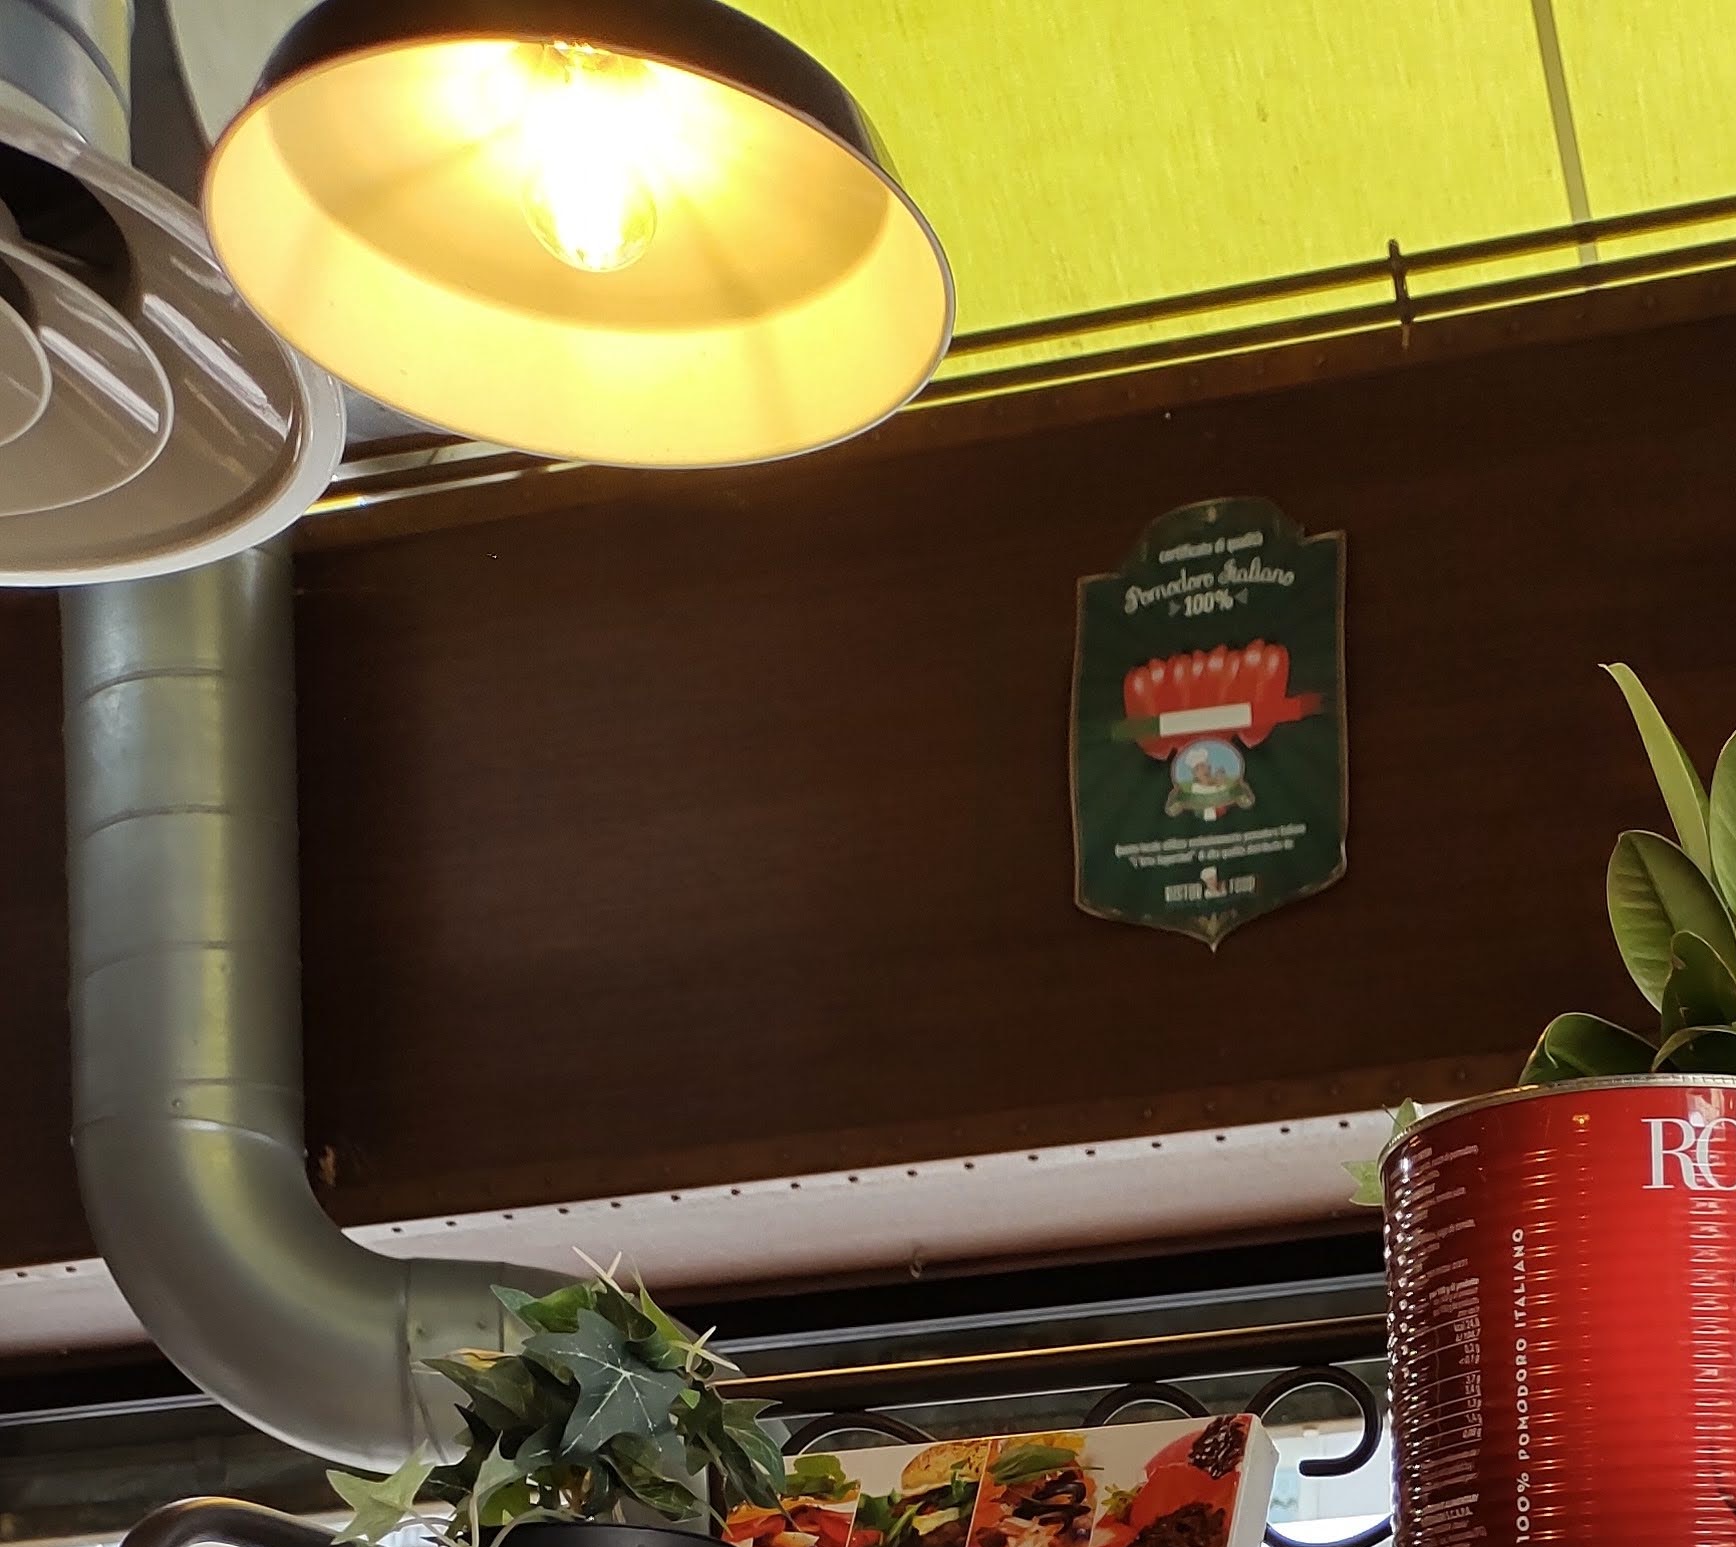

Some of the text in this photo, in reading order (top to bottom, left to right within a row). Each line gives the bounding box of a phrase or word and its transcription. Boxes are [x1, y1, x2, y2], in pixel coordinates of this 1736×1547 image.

[1184, 588, 1235, 617] 100%
[1511, 1228, 1531, 1544] 100% POMODORO ITALIANO
